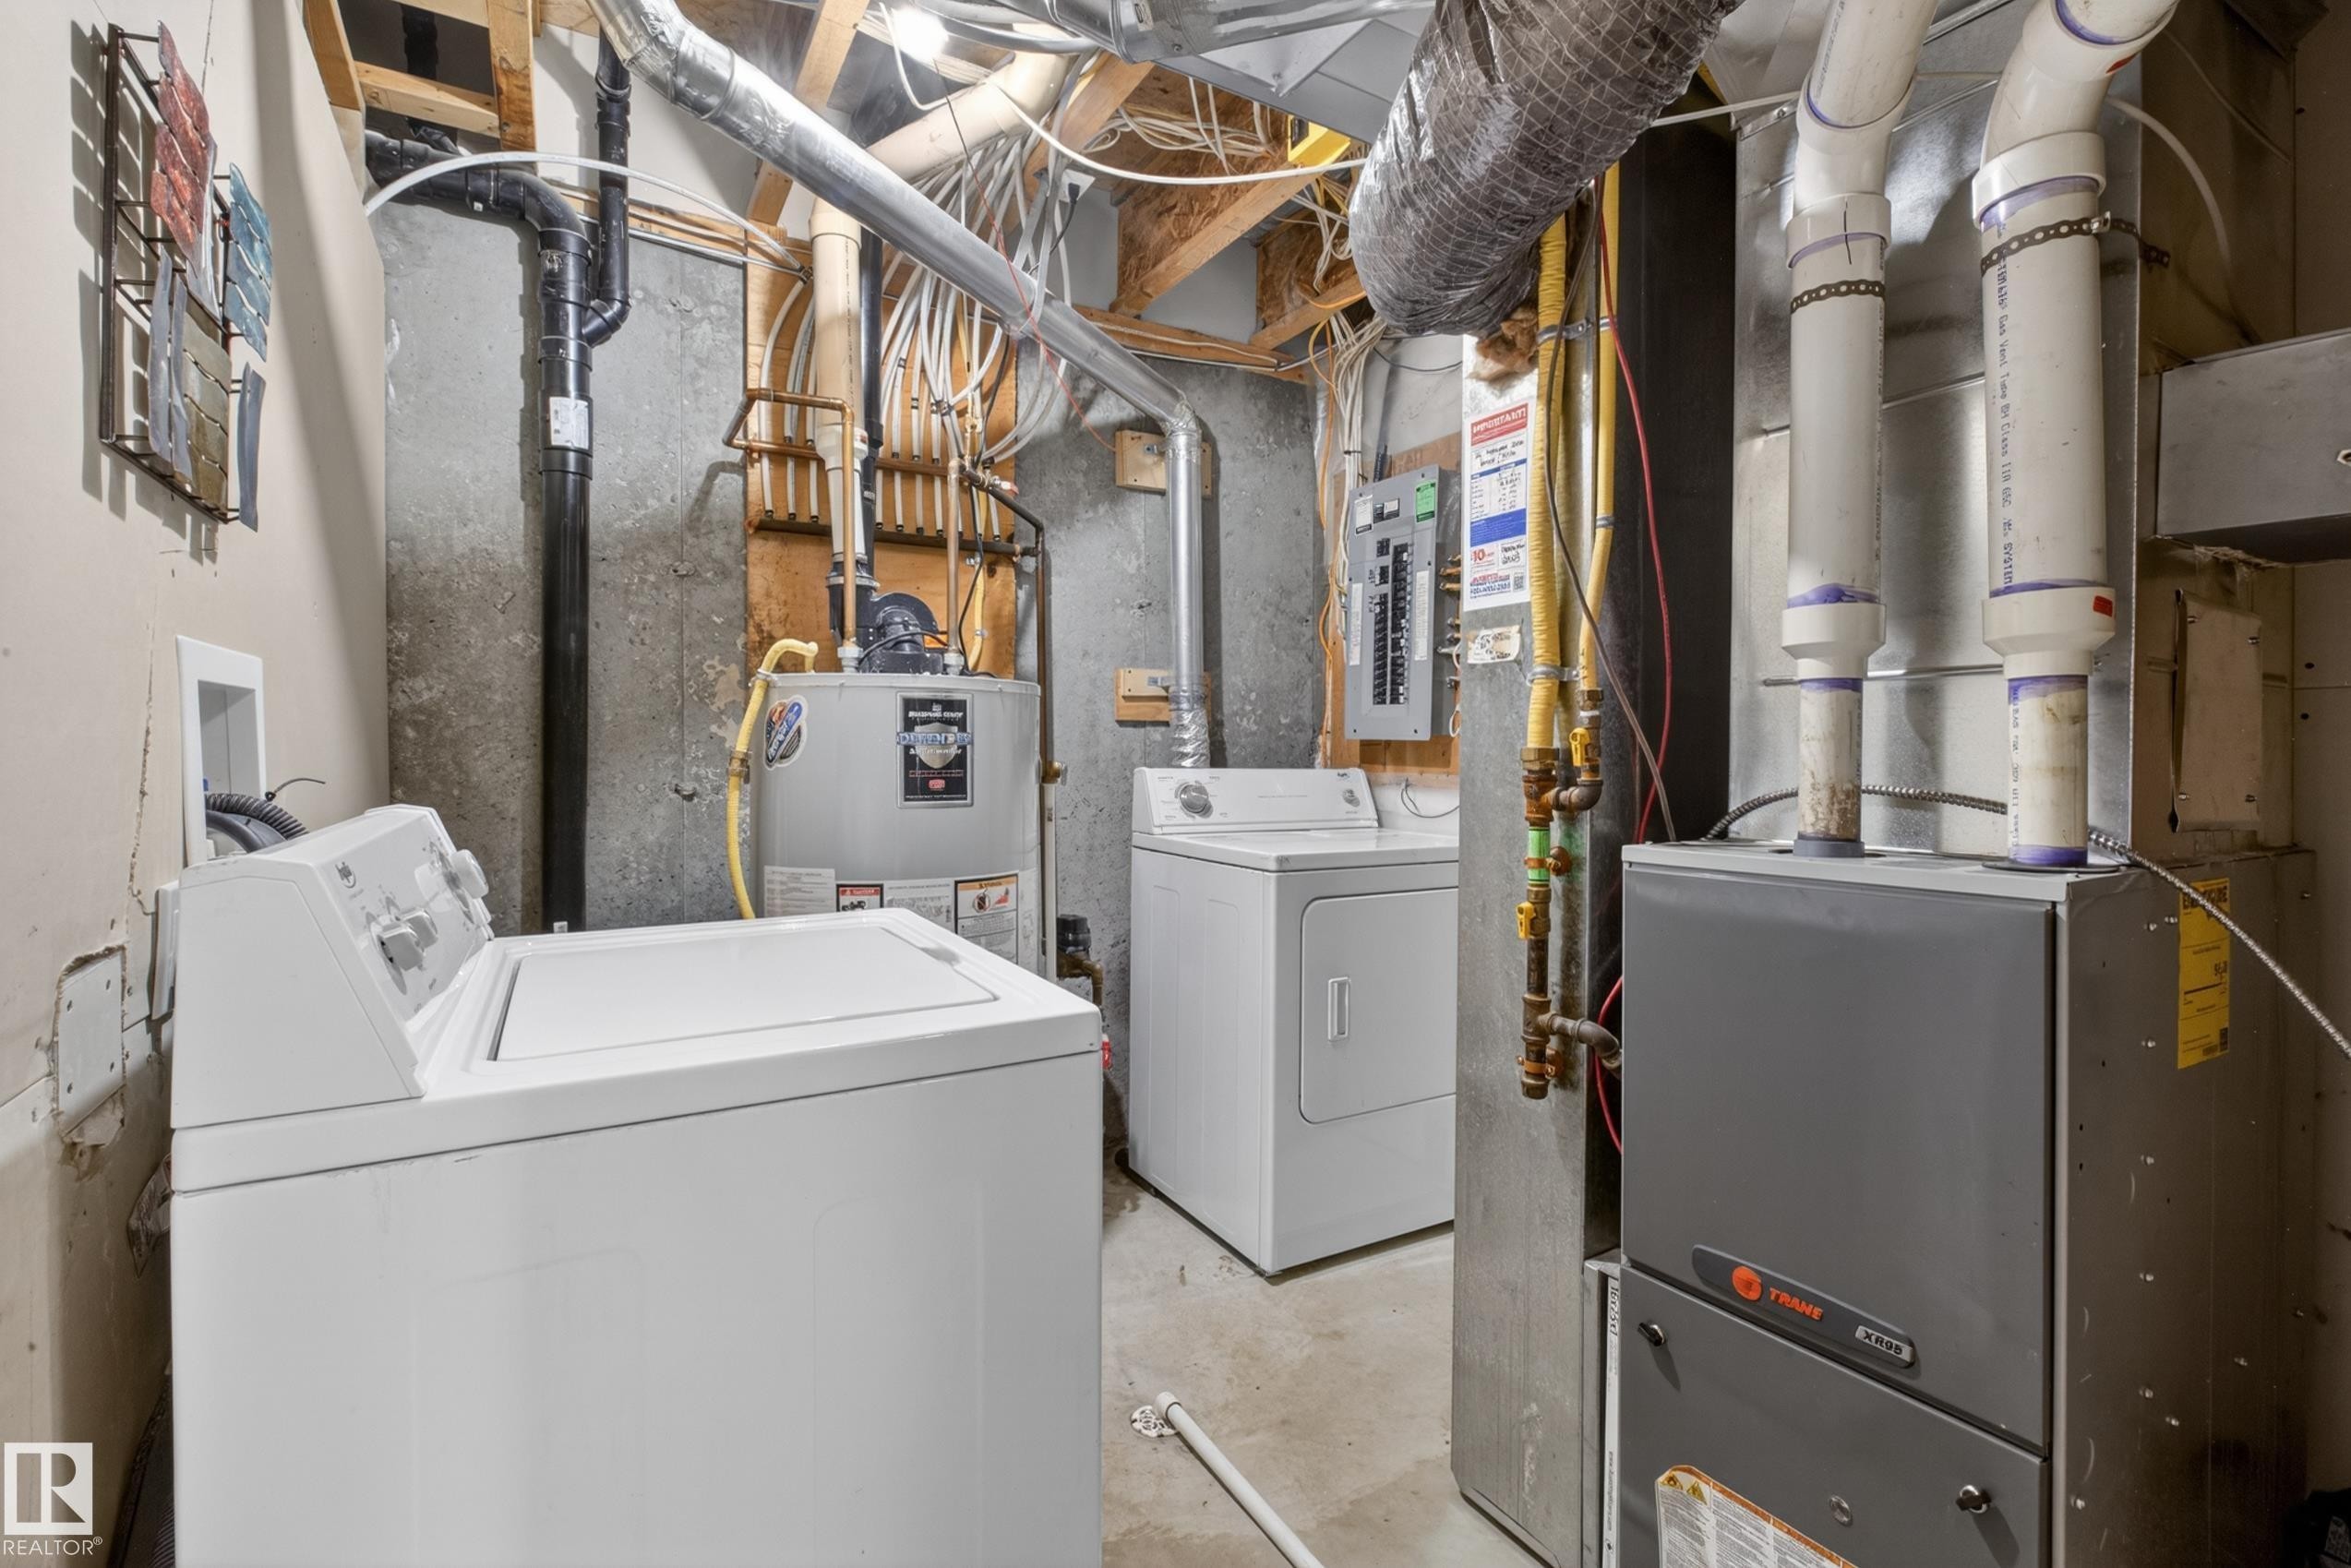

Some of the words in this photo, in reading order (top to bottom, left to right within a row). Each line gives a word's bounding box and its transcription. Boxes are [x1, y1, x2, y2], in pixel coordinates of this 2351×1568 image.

[1998, 339, 2009, 367] Vent
[2001, 422, 2011, 458] Class
[1768, 1287, 1824, 1322] TRANE
[1862, 1329, 1904, 1357] XR95
